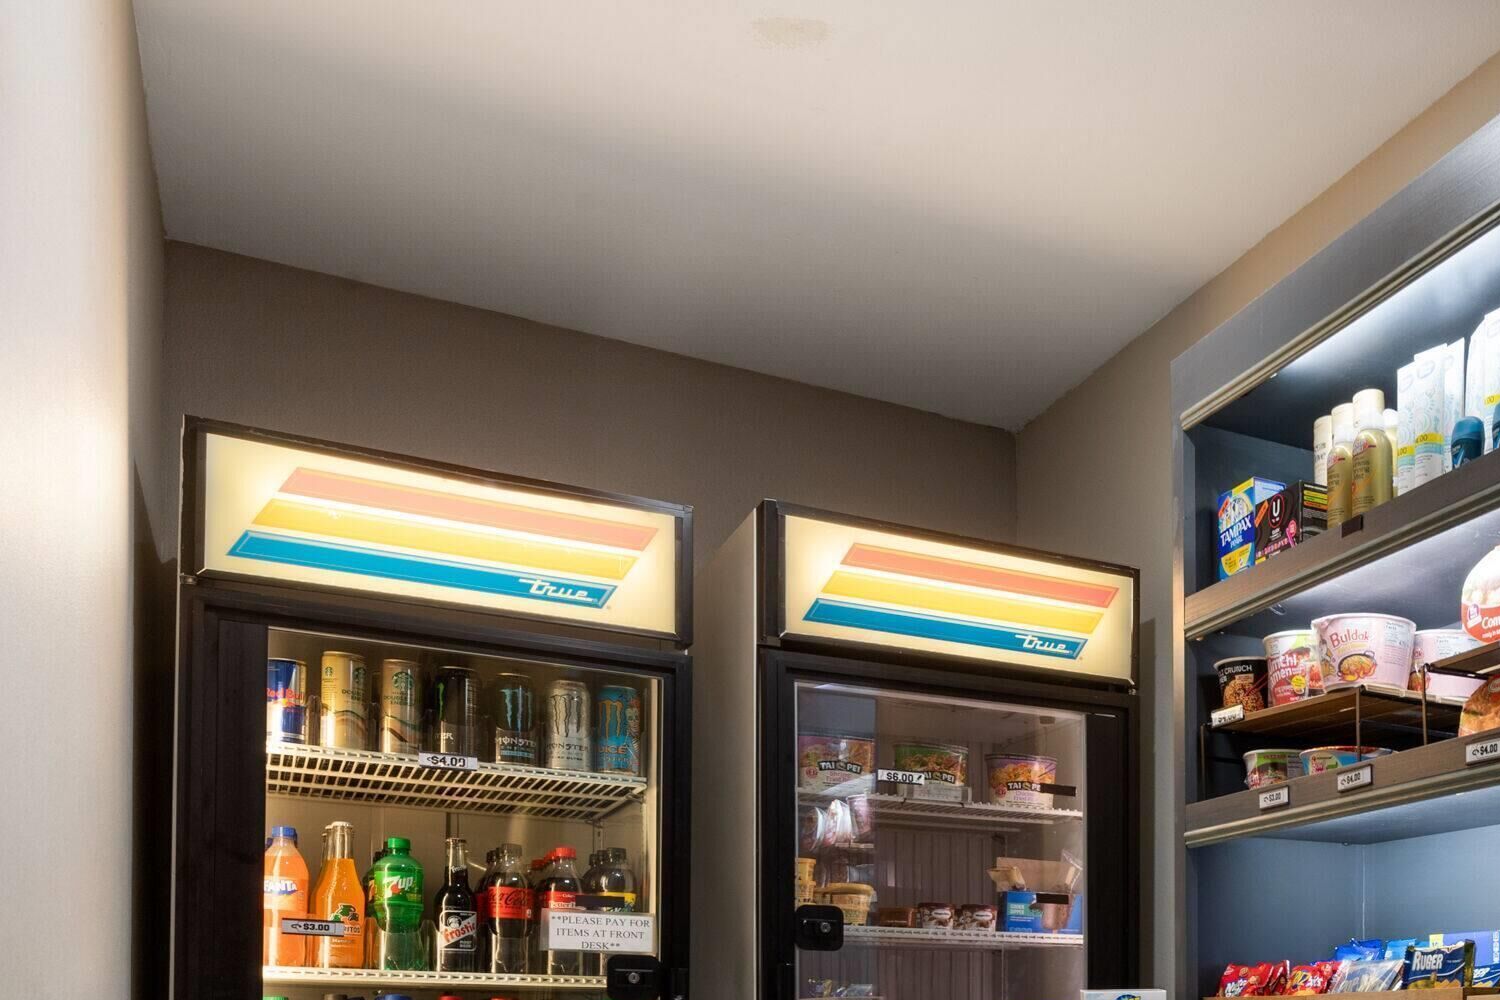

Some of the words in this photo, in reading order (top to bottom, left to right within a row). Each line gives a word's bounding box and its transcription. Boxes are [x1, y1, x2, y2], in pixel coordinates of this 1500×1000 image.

[1220, 515, 1252, 547] TAMPAX
[519, 577, 594, 602] true
[1016, 634, 1073, 654] true
[1329, 629, 1370, 649] Buldak
[1225, 665, 1253, 675] CRUNCH
[431, 755, 466, 767] $4.00
[820, 762, 836, 771] TAI
[846, 764, 861, 773] PEI
[886, 773, 914, 783] $6.00
[1008, 781, 1022, 790] TAI
[303, 923, 330, 931] $3.00
[605, 918, 625, 926] PAY
[629, 919, 650, 928] FOR
[556, 928, 590, 937] ITEMS
[592, 929, 606, 938] AT
[609, 930, 644, 940] FRONT
